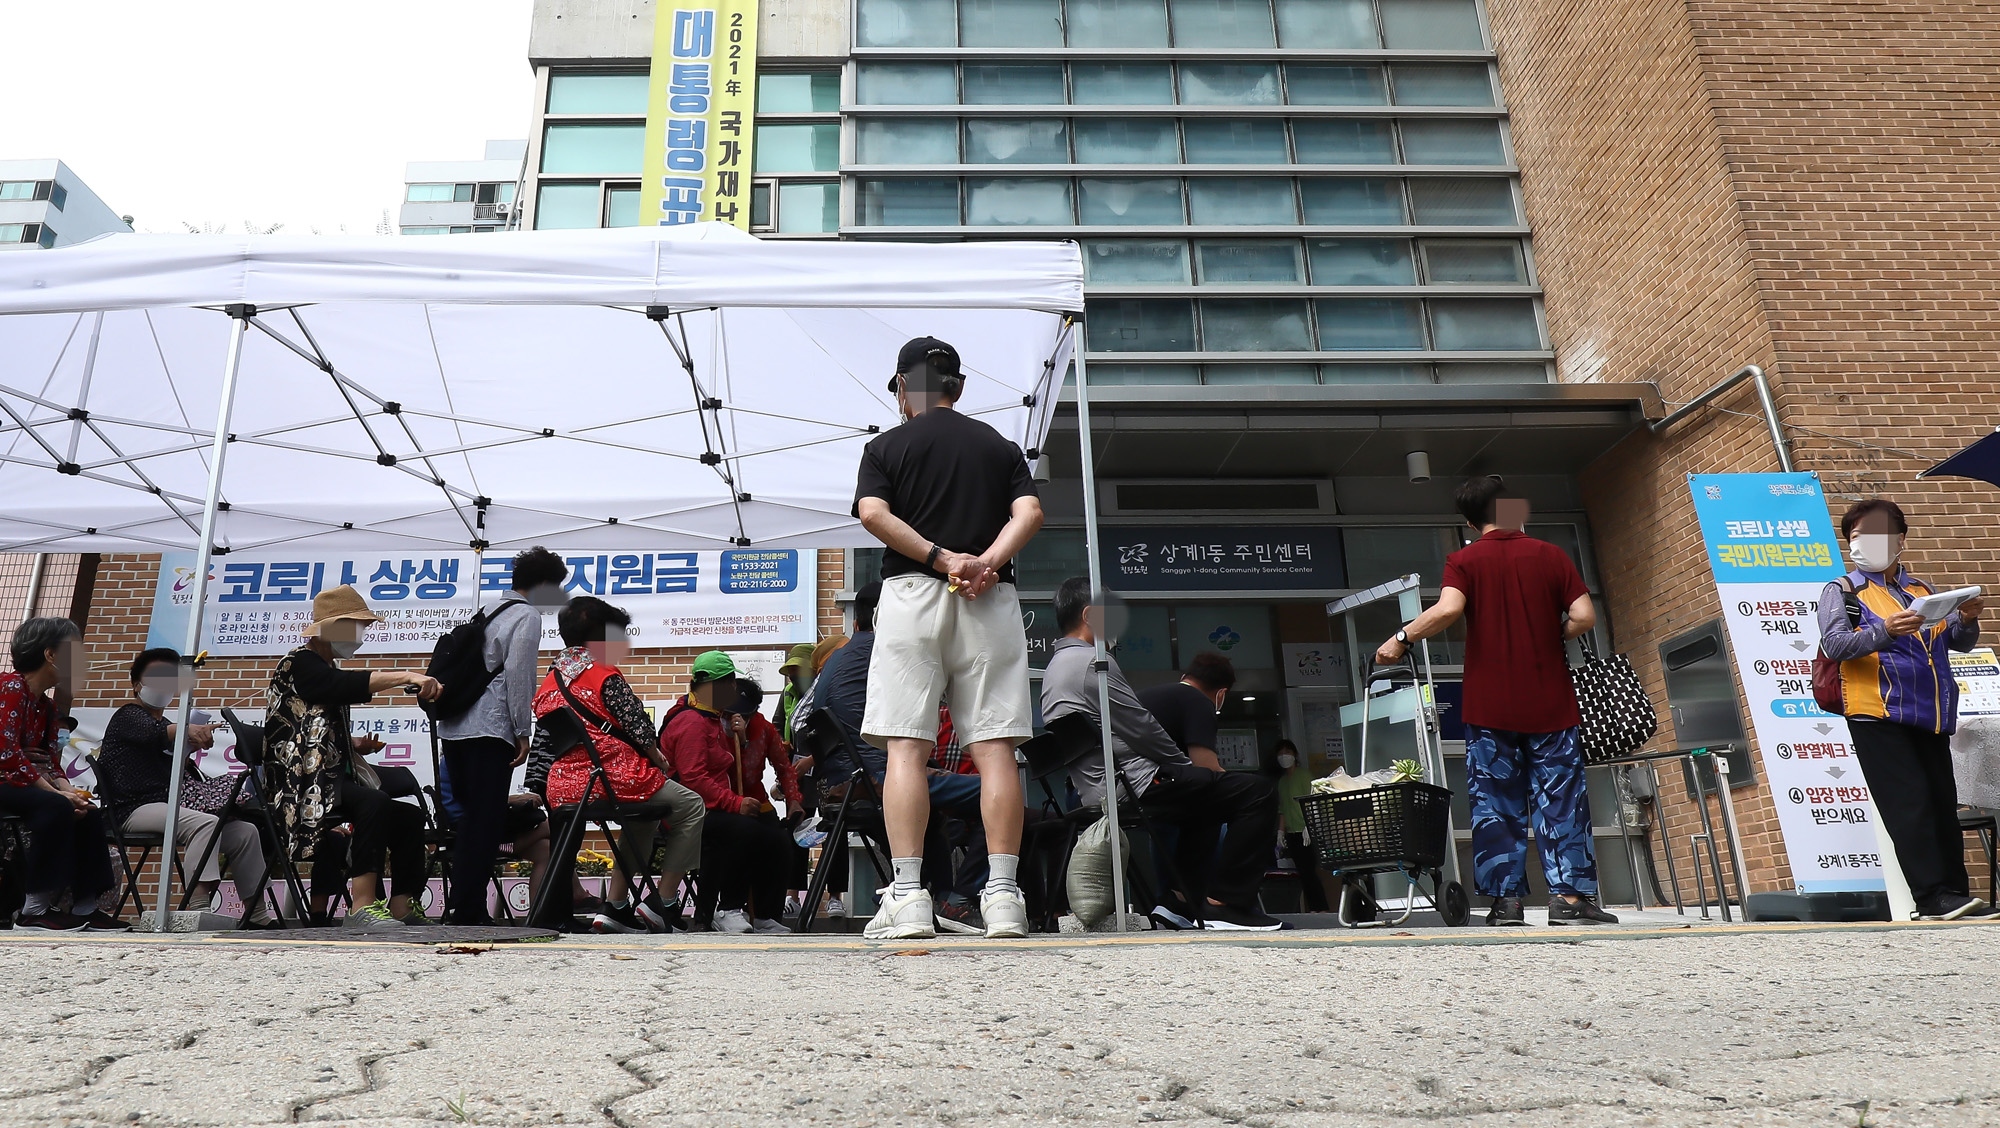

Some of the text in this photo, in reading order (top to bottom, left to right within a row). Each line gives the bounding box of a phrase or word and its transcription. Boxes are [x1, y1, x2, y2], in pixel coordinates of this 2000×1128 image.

[725, 12, 743, 97] 2021年
[1725, 520, 1811, 538] 코로나 상생
[1160, 543, 1312, 563] 상계1동 주민센터
[1717, 542, 1833, 568] 국민지원금신청
[740, 561, 778, 571] 1533-2021
[1160, 567, 1191, 575] Sanggye
[1193, 566, 1218, 575] 1-dong
[1219, 566, 1261, 574] Community
[218, 552, 700, 602] 코로나 상생 국지원금
[738, 579, 787, 588] 02-2116-2000
[371, 609, 401, 618] 페이지
[405, 609, 414, 618] 및
[416, 608, 449, 618] 네이버앱
[1755, 601, 1808, 617] 신분증을
[218, 623, 269, 633] 온라인신청
[392, 621, 417, 629] 18:00
[679, 617, 707, 626] 주민센터
[708, 616, 742, 626] 방문신청은
[743, 615, 765, 624] 혼잡이
[765, 614, 780, 623] 우려
[781, 614, 802, 623] 되오니
[1760, 620, 1802, 635] 주세요
[216, 634, 268, 644] 오프라인신청
[394, 632, 419, 641] 18:00
[670, 625, 780, 636] 가급적 온라인 신청을 당부드립니다.
[1771, 659, 1813, 675] 안심콜
[1777, 679, 1805, 695] 걸어
[1793, 742, 1848, 759] 발열체크
[1805, 787, 1835, 804] 입장
[1810, 807, 1868, 825] 받으세요
